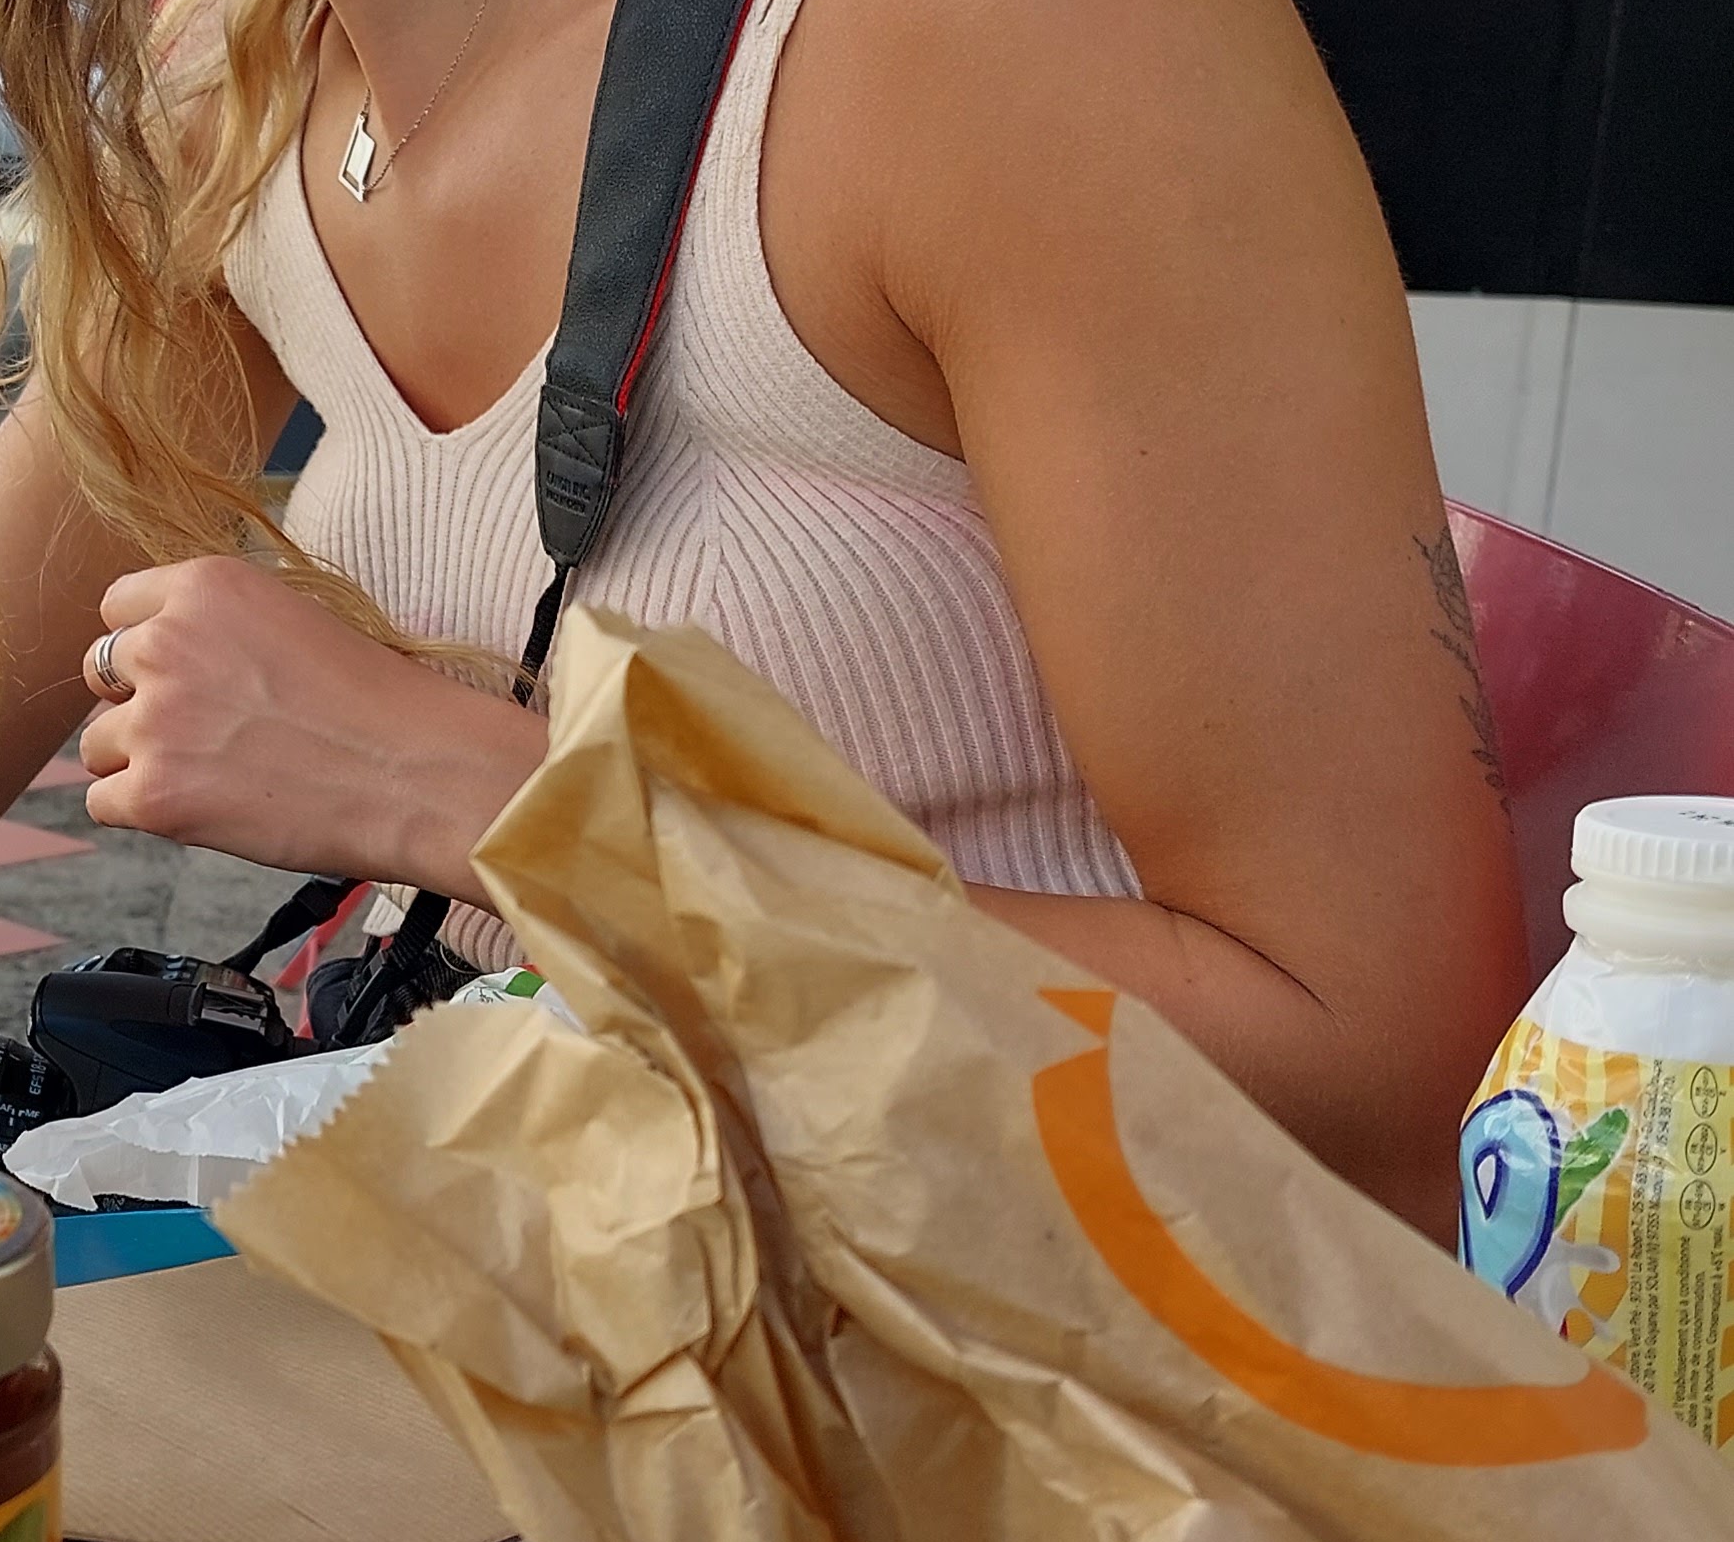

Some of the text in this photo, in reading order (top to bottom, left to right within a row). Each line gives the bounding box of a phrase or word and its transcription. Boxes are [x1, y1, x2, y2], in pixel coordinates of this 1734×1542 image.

[0, 1102, 41, 1119] AF MF
[1676, 1235, 1691, 1298] conditionné
